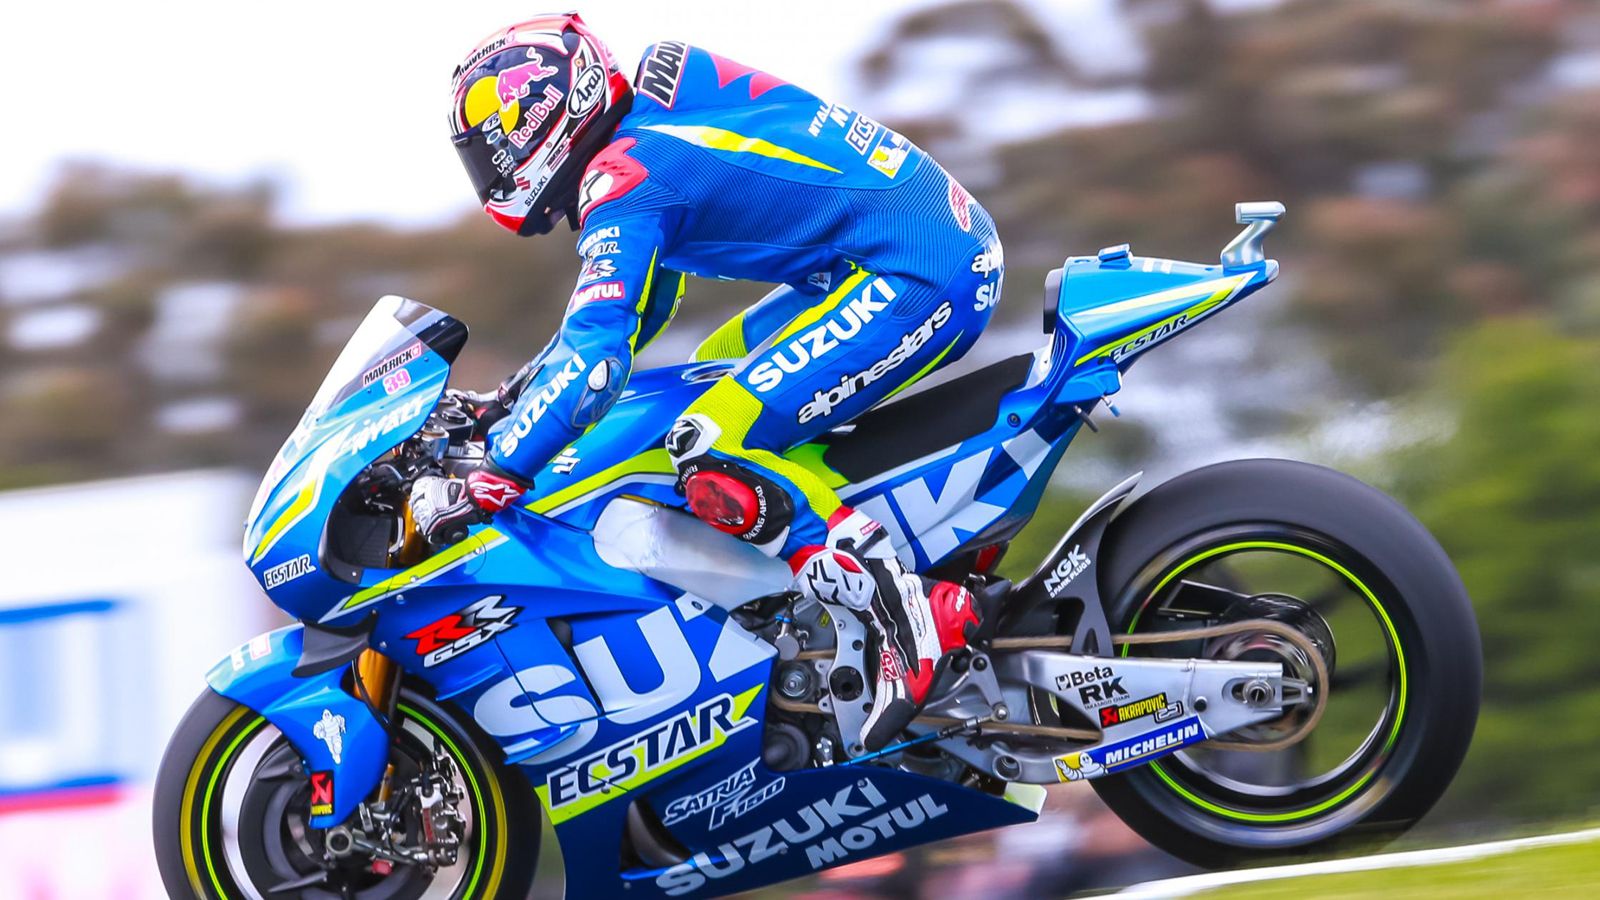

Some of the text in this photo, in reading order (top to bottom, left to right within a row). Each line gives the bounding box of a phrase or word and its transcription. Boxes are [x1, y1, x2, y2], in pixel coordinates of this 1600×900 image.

[576, 68, 601, 113] Arai
[525, 176, 548, 206] SUZUKI
[748, 277, 897, 393] SUZUKI
[1110, 313, 1188, 362] ECSTAR
[364, 351, 413, 385] MAVERICK
[385, 369, 410, 393] 39
[798, 301, 953, 424] alpinestars
[500, 353, 587, 457] SUZUKI
[265, 556, 314, 588] ECSTAR
[1043, 544, 1087, 593] NGK
[1070, 666, 1113, 687] Beta
[1078, 676, 1129, 705] RK
[547, 693, 757, 809] ECSTAR
[1105, 723, 1199, 765] MICHELIN
[662, 756, 761, 827] SATRIA
[656, 777, 887, 896] SUZUKI
[805, 794, 949, 870] MOTUL
